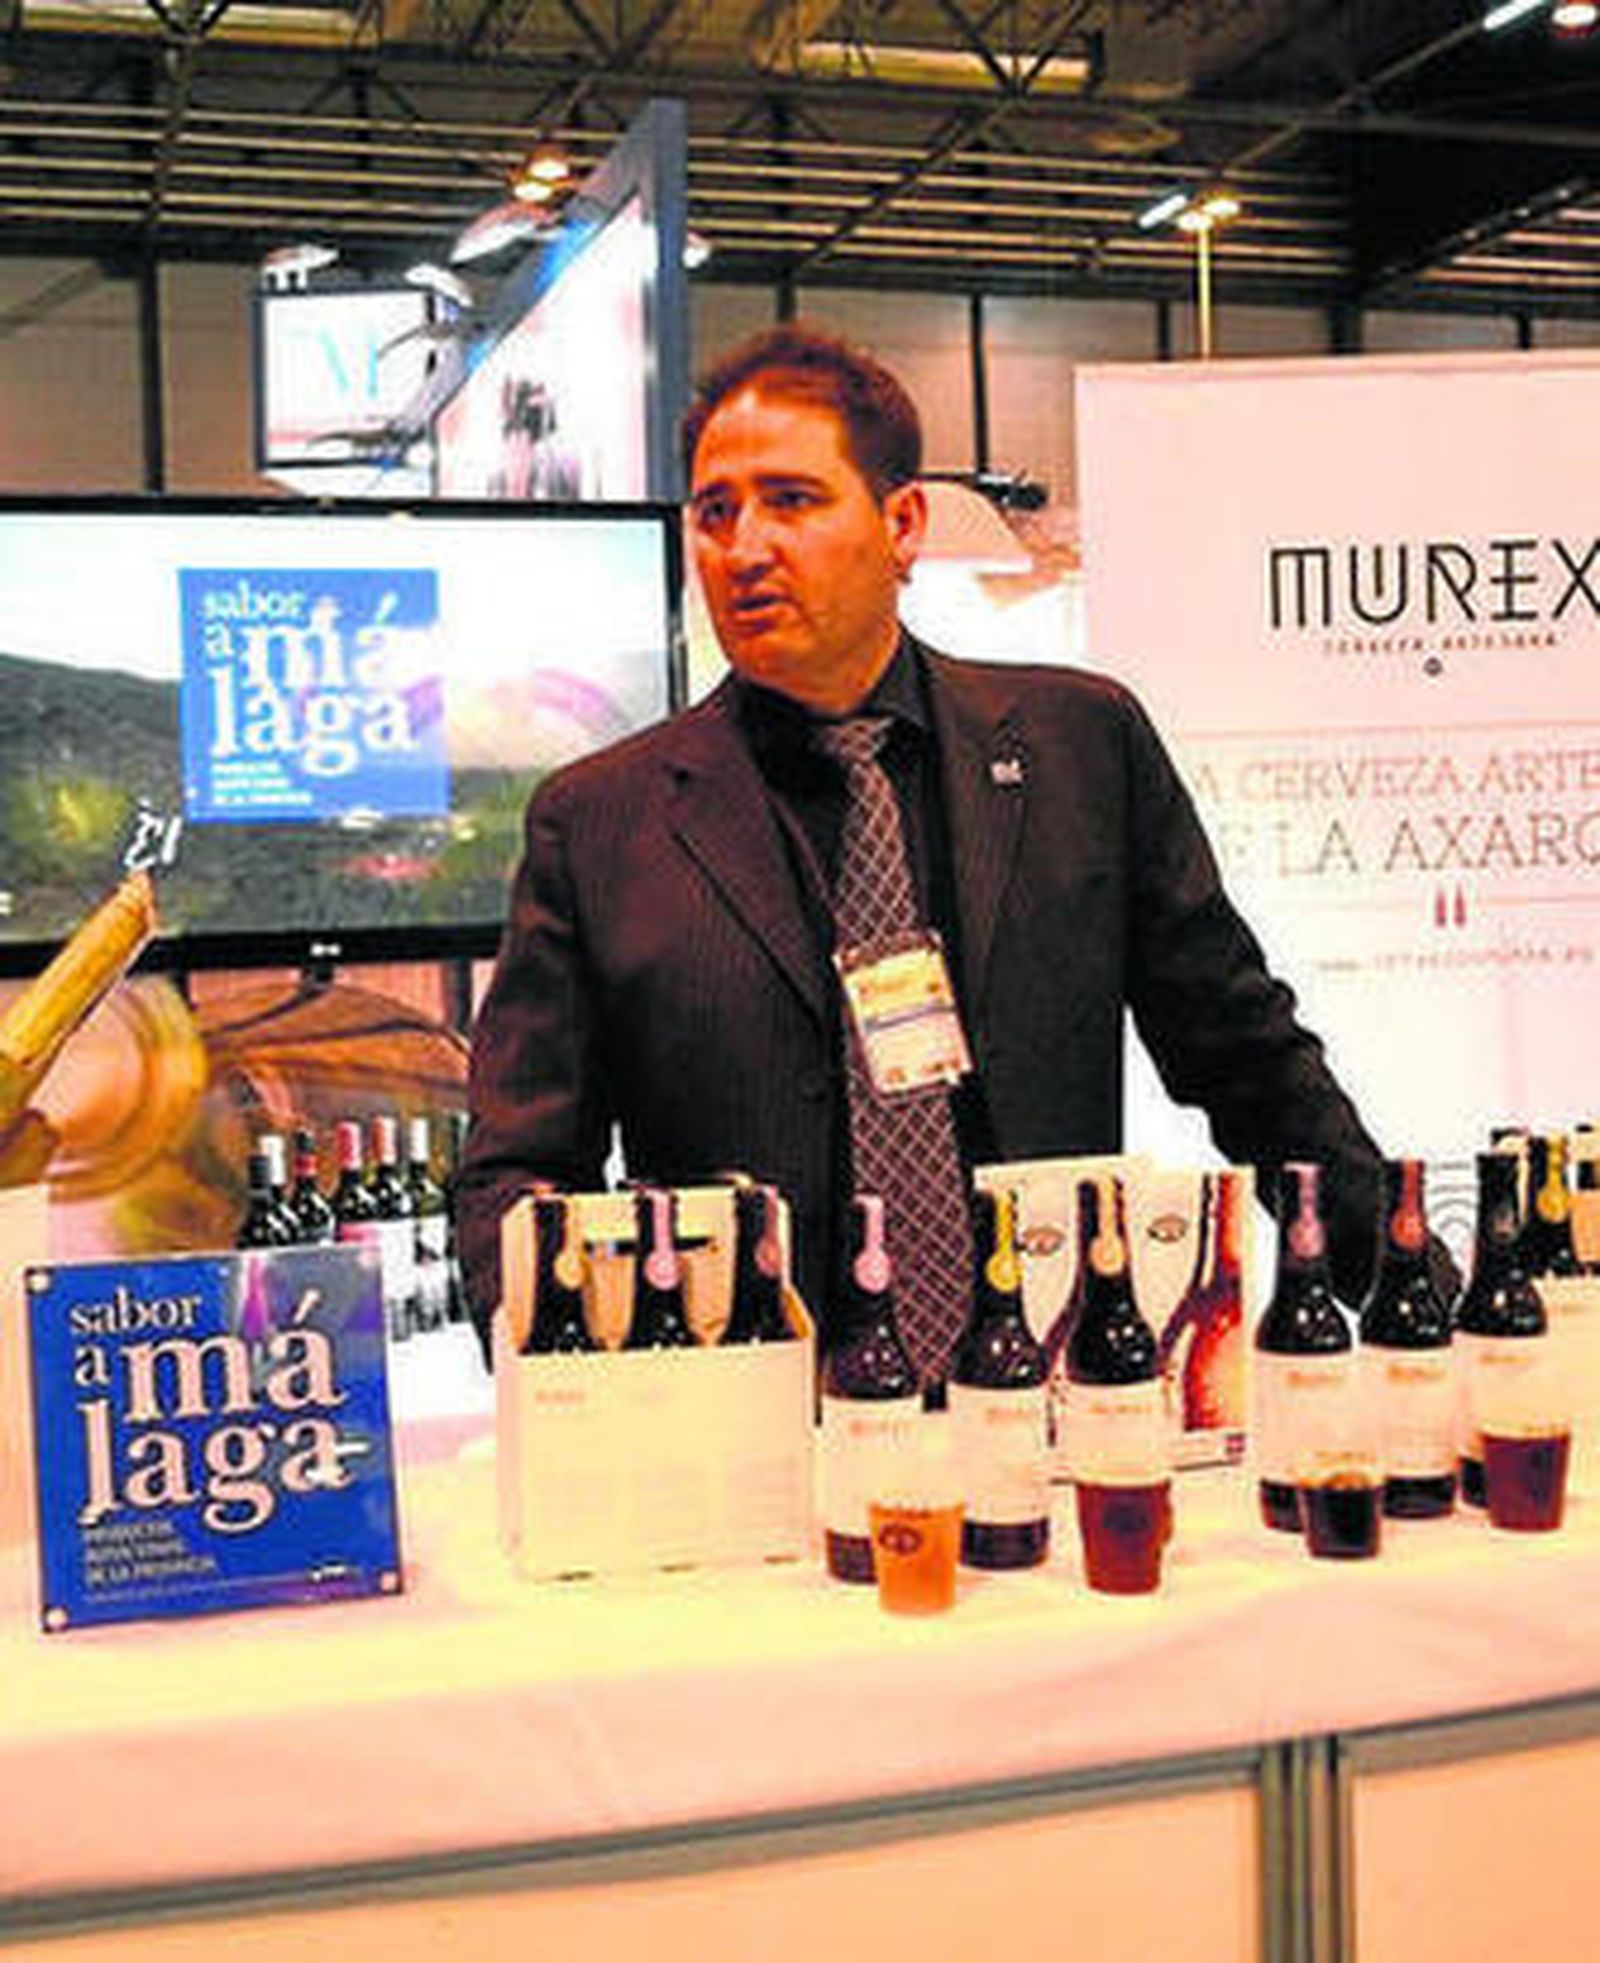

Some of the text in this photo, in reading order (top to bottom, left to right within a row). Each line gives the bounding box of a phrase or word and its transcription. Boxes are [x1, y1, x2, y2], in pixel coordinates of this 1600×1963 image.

[203, 578, 305, 618] sabor
[1270, 539, 1600, 628] MUREX
[211, 667, 421, 776] laga
[1235, 755, 1463, 802] CERVEZA
[1274, 818, 1359, 876] LA
[69, 1285, 202, 1335] sabor
[74, 1345, 109, 1386] a
[119, 1289, 349, 1423] má
[77, 1400, 354, 1532] laga
